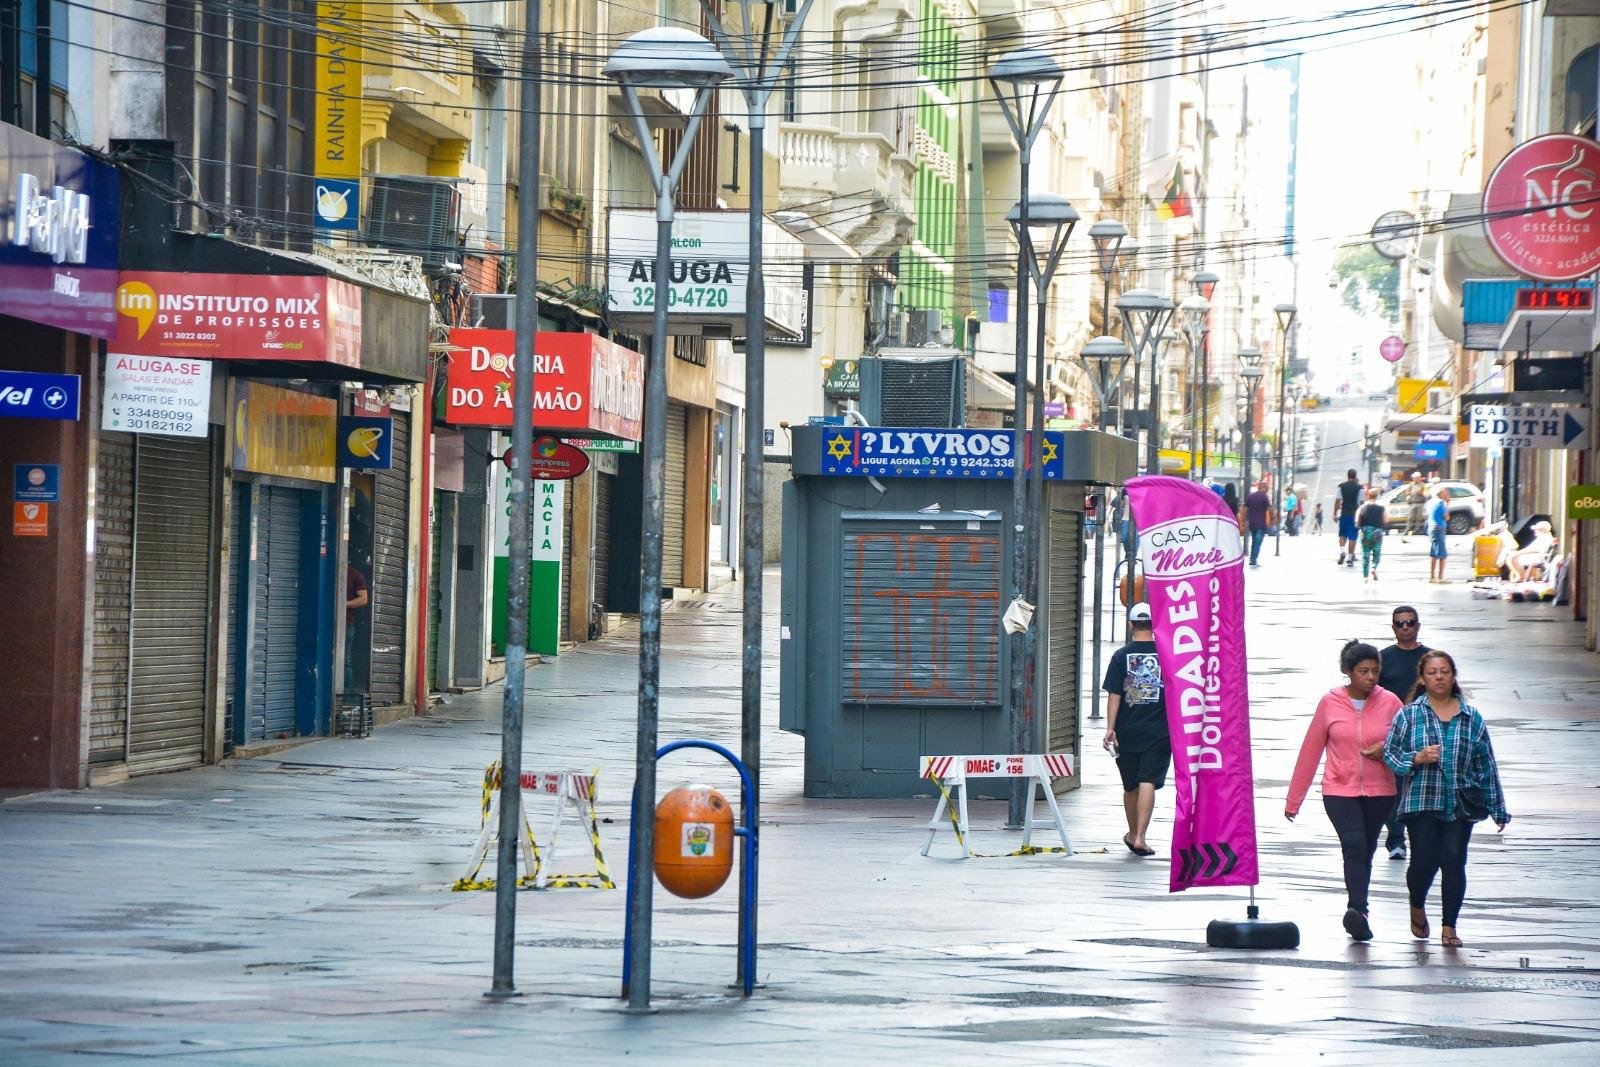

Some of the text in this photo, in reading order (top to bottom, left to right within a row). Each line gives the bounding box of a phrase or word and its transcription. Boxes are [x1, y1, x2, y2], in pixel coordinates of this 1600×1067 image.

[327, 84, 345, 161] RAINHA
[1524, 179, 1594, 220] NC
[1523, 218, 1591, 233] estética
[671, 238, 701, 248] ALCON
[1499, 231, 1544, 266] pilates
[158, 294, 319, 315] INSTITUTO MIX
[633, 286, 728, 308] 320-4720
[159, 314, 321, 329] DE PROFISSÕES
[176, 332, 195, 340] 3022
[116, 357, 201, 376] ALUGA-SE
[121, 374, 194, 387] SALAS E ANDAR
[111, 393, 120, 401] A
[120, 394, 158, 405] PARTIR
[160, 396, 174, 405] DE
[452, 386, 583, 411] DO AMÃO
[127, 407, 193, 421] 33489099
[1474, 406, 1560, 418] GALERIA
[127, 418, 193, 432] 30182162
[1473, 418, 1560, 436] EDITH
[1498, 438, 1532, 447] 1273
[861, 457, 888, 465] LIGUE
[932, 457, 946, 466] 51
[950, 457, 958, 467] 9
[542, 483, 555, 550] MÁCIA
[1151, 525, 1206, 548] CASA
[966, 760, 995, 774] DMAE
[1006, 766, 1024, 774] 156
[520, 774, 537, 790] MAE
